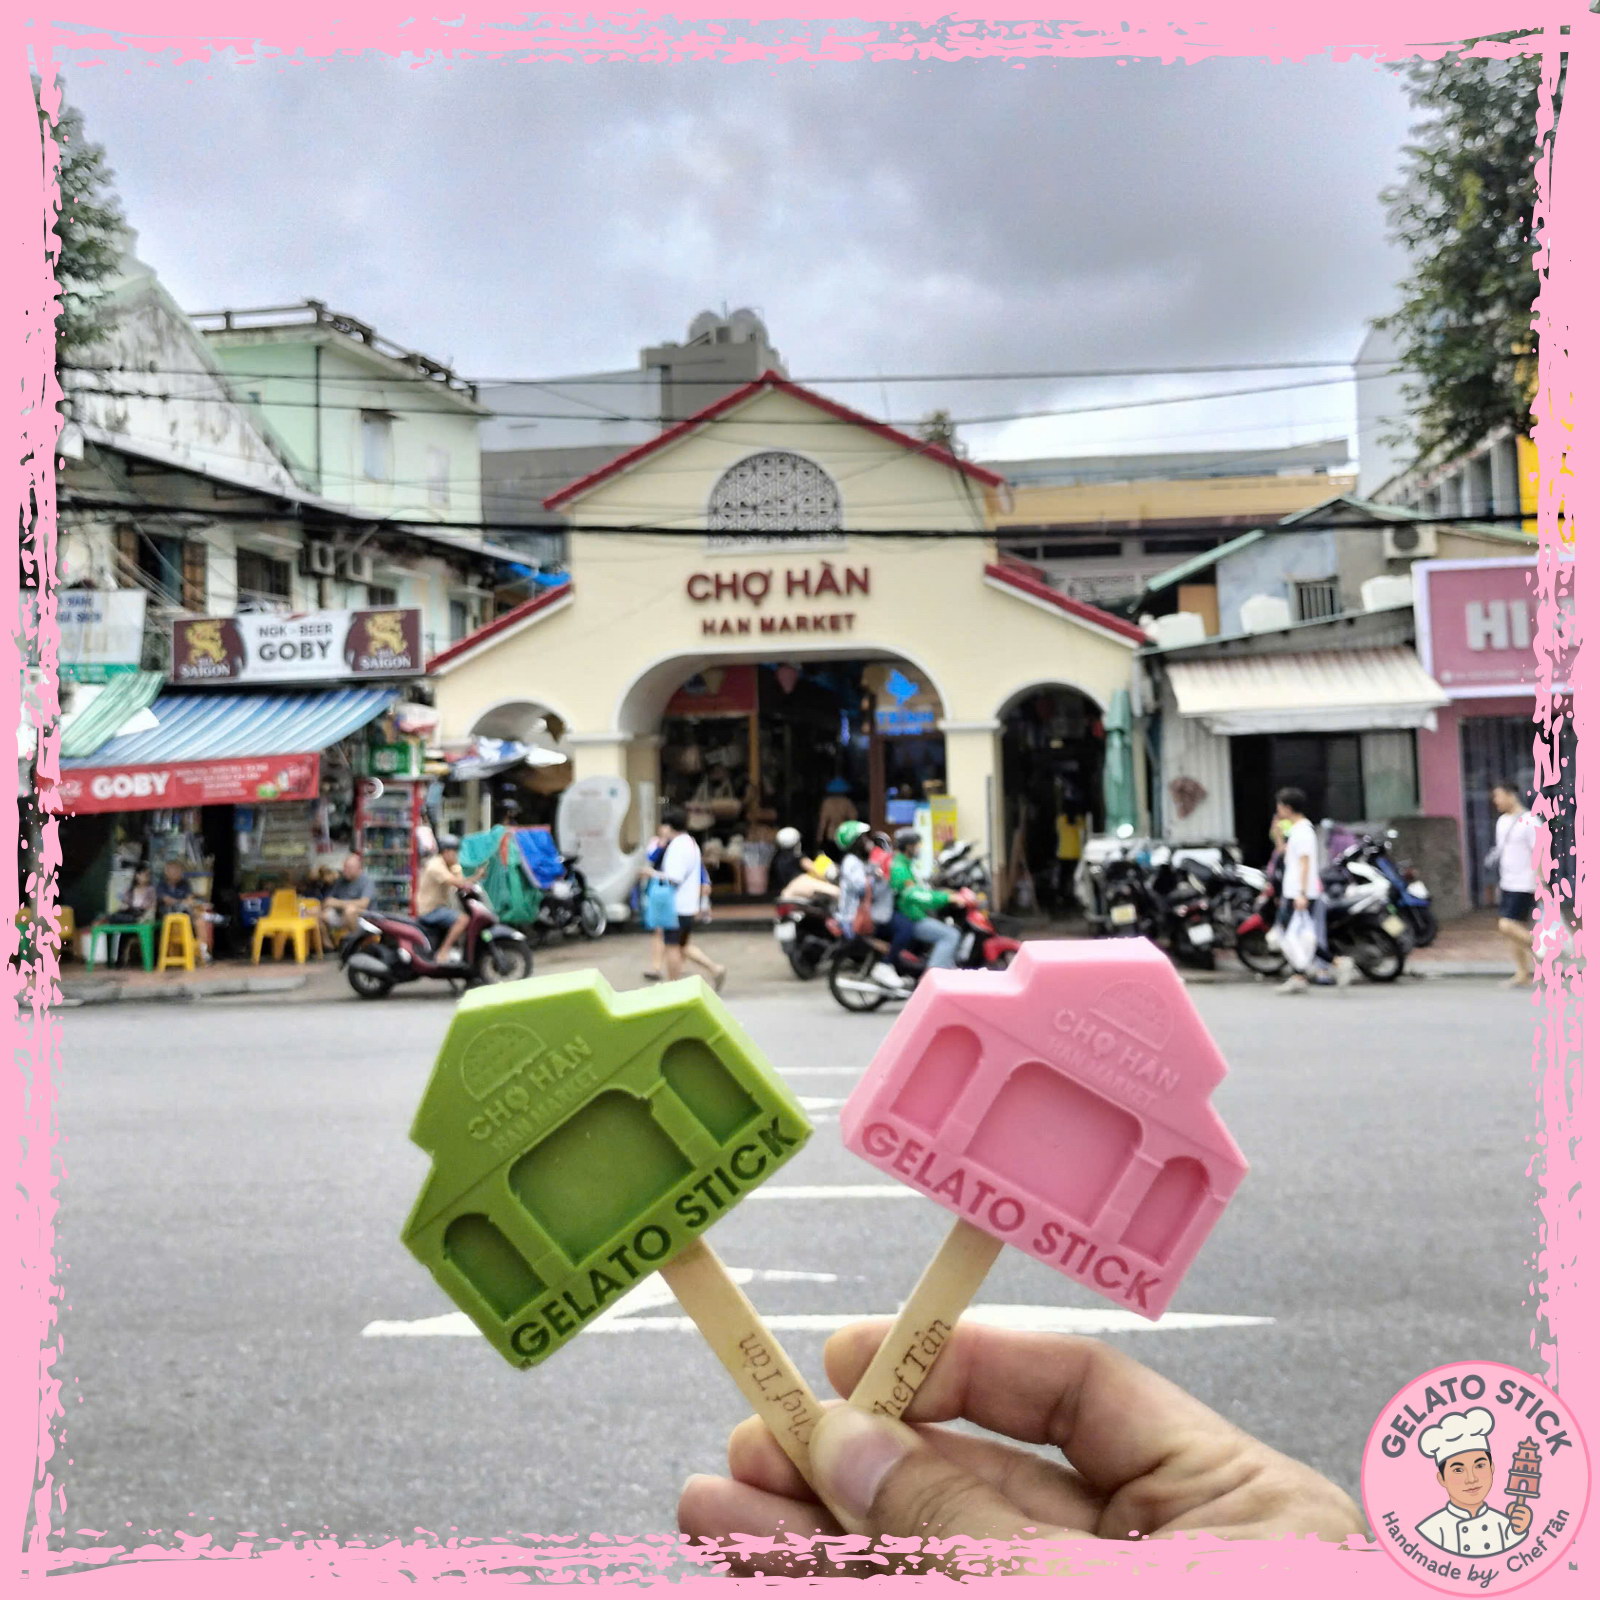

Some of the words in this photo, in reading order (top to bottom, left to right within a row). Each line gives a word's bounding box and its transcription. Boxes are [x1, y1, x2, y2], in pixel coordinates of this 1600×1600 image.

[686, 570, 773, 607] CHỢ
[785, 561, 870, 598] HÀN
[258, 624, 288, 637] NGK
[300, 623, 334, 636] BEER
[702, 617, 751, 634] HAN
[760, 613, 857, 634] MARKET
[258, 640, 333, 661] GOBY
[180, 663, 231, 678] SAIGON
[359, 656, 412, 670] SAIGON
[91, 772, 170, 799] GOBY
[861, 1122, 1026, 1232] GELATO
[1032, 1222, 1161, 1310] STICK
[510, 1224, 672, 1357] GELATO
[674, 1117, 797, 1228] STICK
